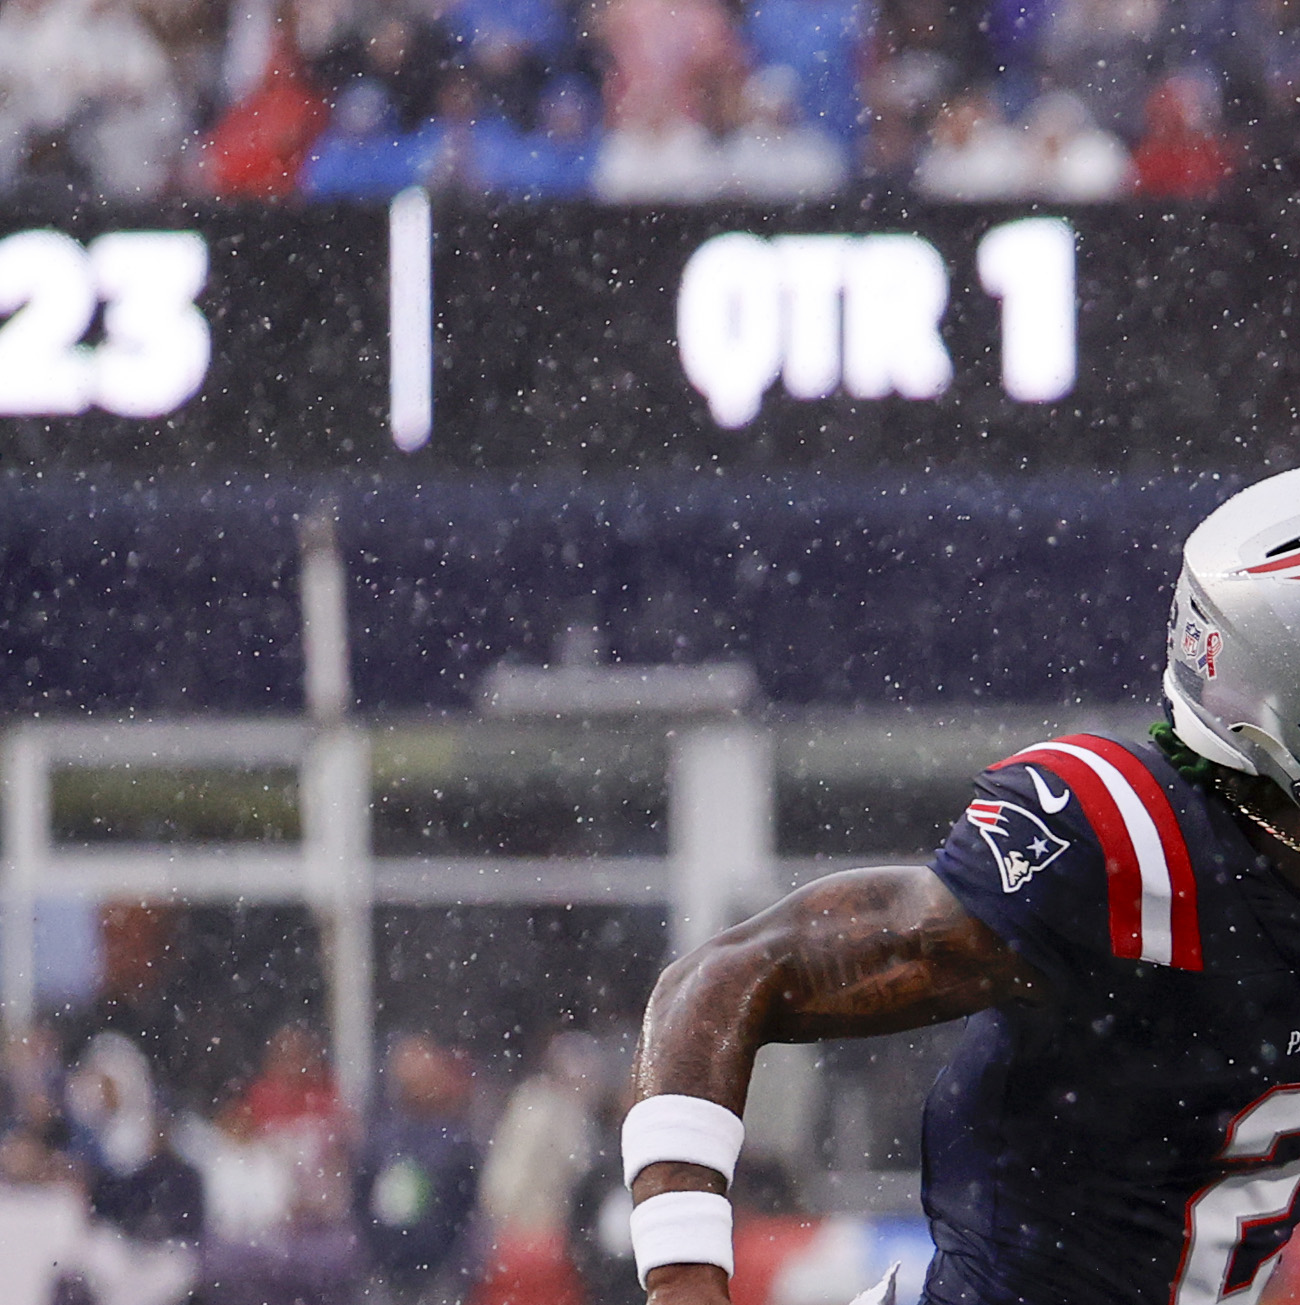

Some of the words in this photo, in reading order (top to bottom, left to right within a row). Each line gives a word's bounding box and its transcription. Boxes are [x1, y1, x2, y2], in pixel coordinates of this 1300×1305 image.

[0, 231, 210, 415] 23
[677, 232, 952, 426] QTR
[979, 219, 1074, 399] 1
